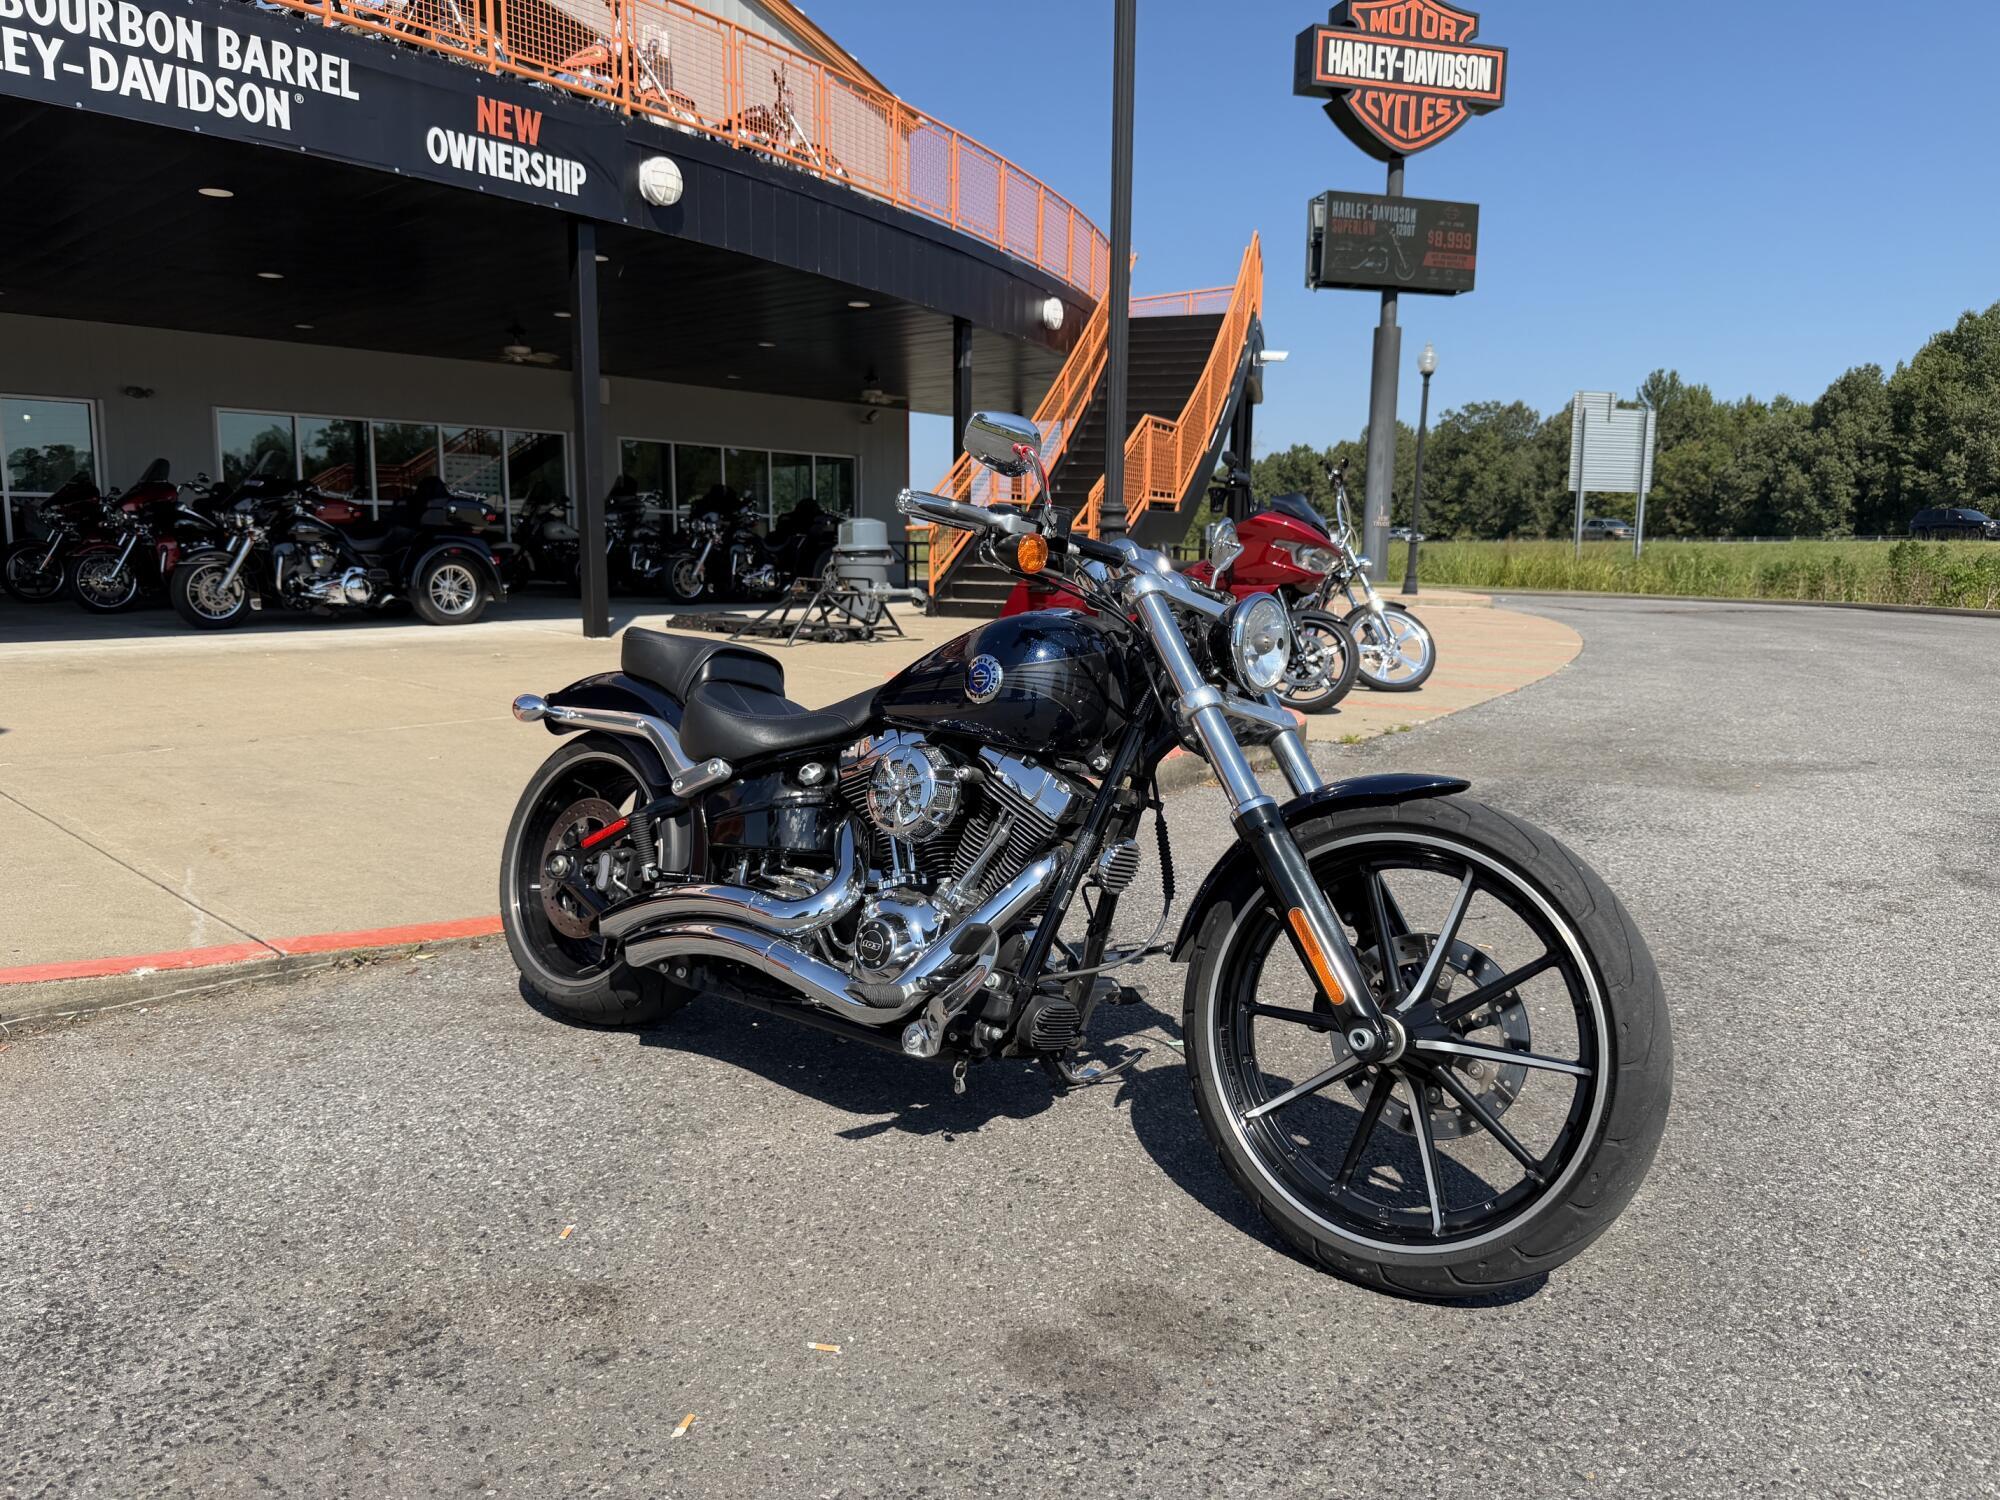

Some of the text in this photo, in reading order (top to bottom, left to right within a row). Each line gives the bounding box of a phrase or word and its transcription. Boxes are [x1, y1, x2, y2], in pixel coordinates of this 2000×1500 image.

[1369, 2, 1456, 43] MOTOR
[218, 27, 361, 102] BARREL
[1327, 39, 1493, 91] HARLEY-DAVIDSON
[476, 95, 543, 146] NEW
[1364, 89, 1452, 140] CYCLES
[426, 126, 587, 197] OWNERSHIP
[1331, 201, 1417, 224] HARLEY-DAVIDSON
[1331, 219, 1377, 236] SUPERLOW
[862, 939, 882, 951] 103
